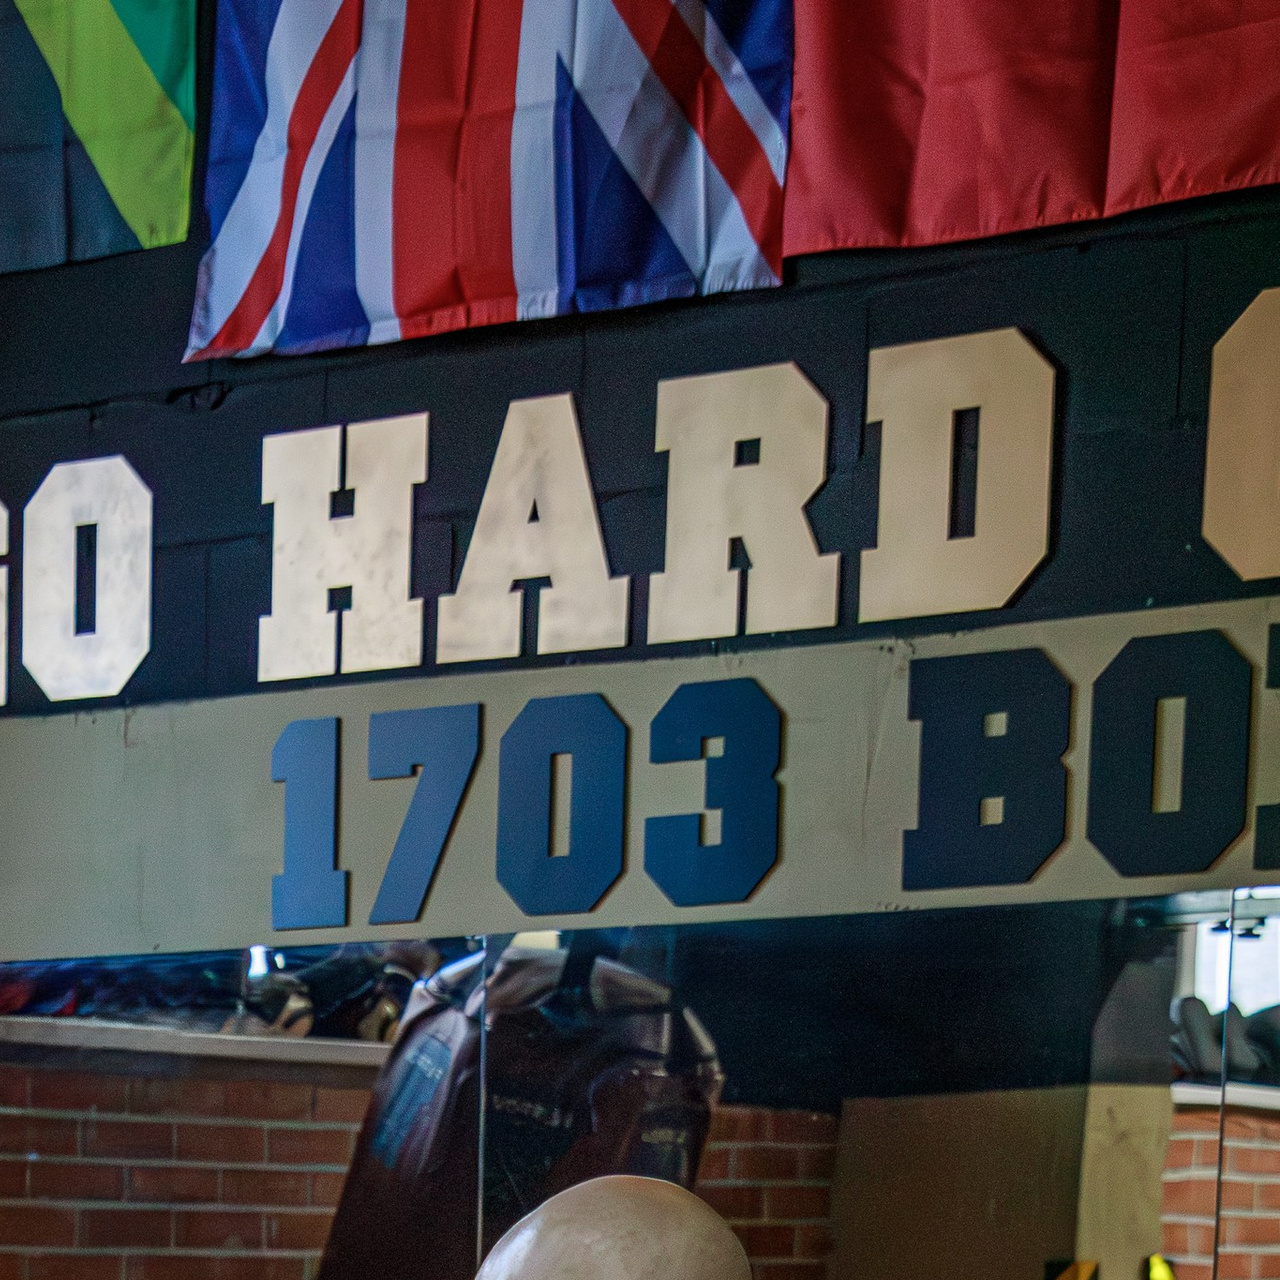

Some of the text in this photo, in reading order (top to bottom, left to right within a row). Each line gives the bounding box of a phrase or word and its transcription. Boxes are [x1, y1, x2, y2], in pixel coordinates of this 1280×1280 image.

[258, 327, 1056, 682] HARD
[271, 626, 1280, 931] 1703 BO
